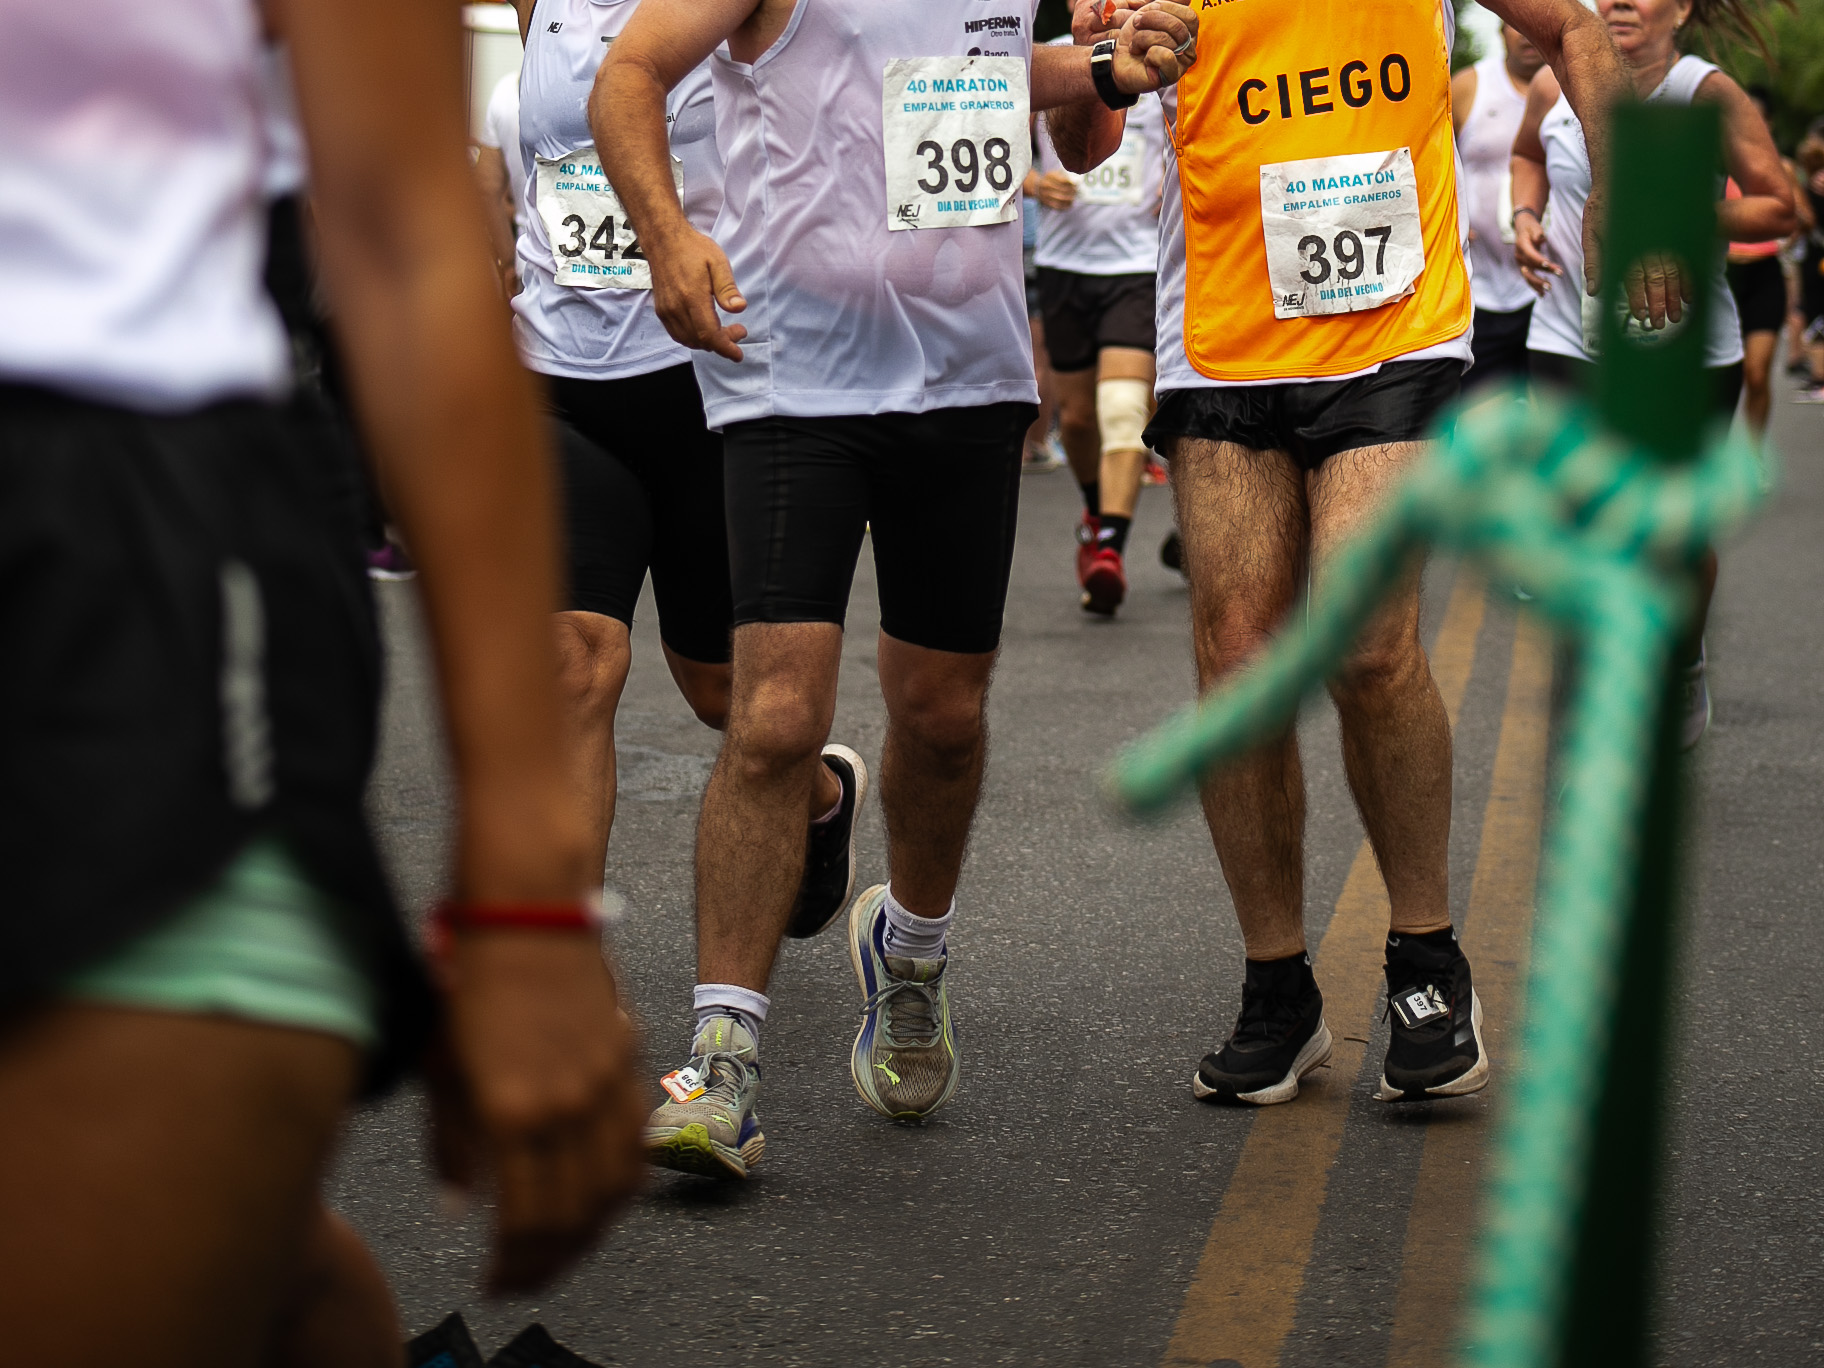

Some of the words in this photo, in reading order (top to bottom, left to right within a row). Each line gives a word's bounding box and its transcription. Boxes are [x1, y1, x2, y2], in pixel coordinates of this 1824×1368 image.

[907, 80, 927, 93] 40
[932, 78, 1008, 93] MARATON
[1237, 53, 1411, 125] CIEGO
[903, 101, 956, 112] EMPALME
[960, 100, 1015, 111] GRANEROS
[560, 163, 576, 176] 40
[916, 137, 1013, 195] 398
[556, 182, 600, 192] EMPALME
[1286, 181, 1306, 194] 40
[937, 200, 952, 212] DIA
[953, 199, 967, 211] DEL
[1283, 197, 1340, 212] EMPALME
[1343, 189, 1402, 206] GRANEROS
[896, 204, 921, 218] NEJ
[1297, 225, 1392, 285] 397
[571, 263, 586, 274] DIA
[1320, 288, 1336, 301] DIA
[1337, 287, 1353, 299] DEL
[1354, 282, 1384, 297] VECINO
[1282, 293, 1306, 307] NEJ
[1413, 996, 1428, 1011] 397
